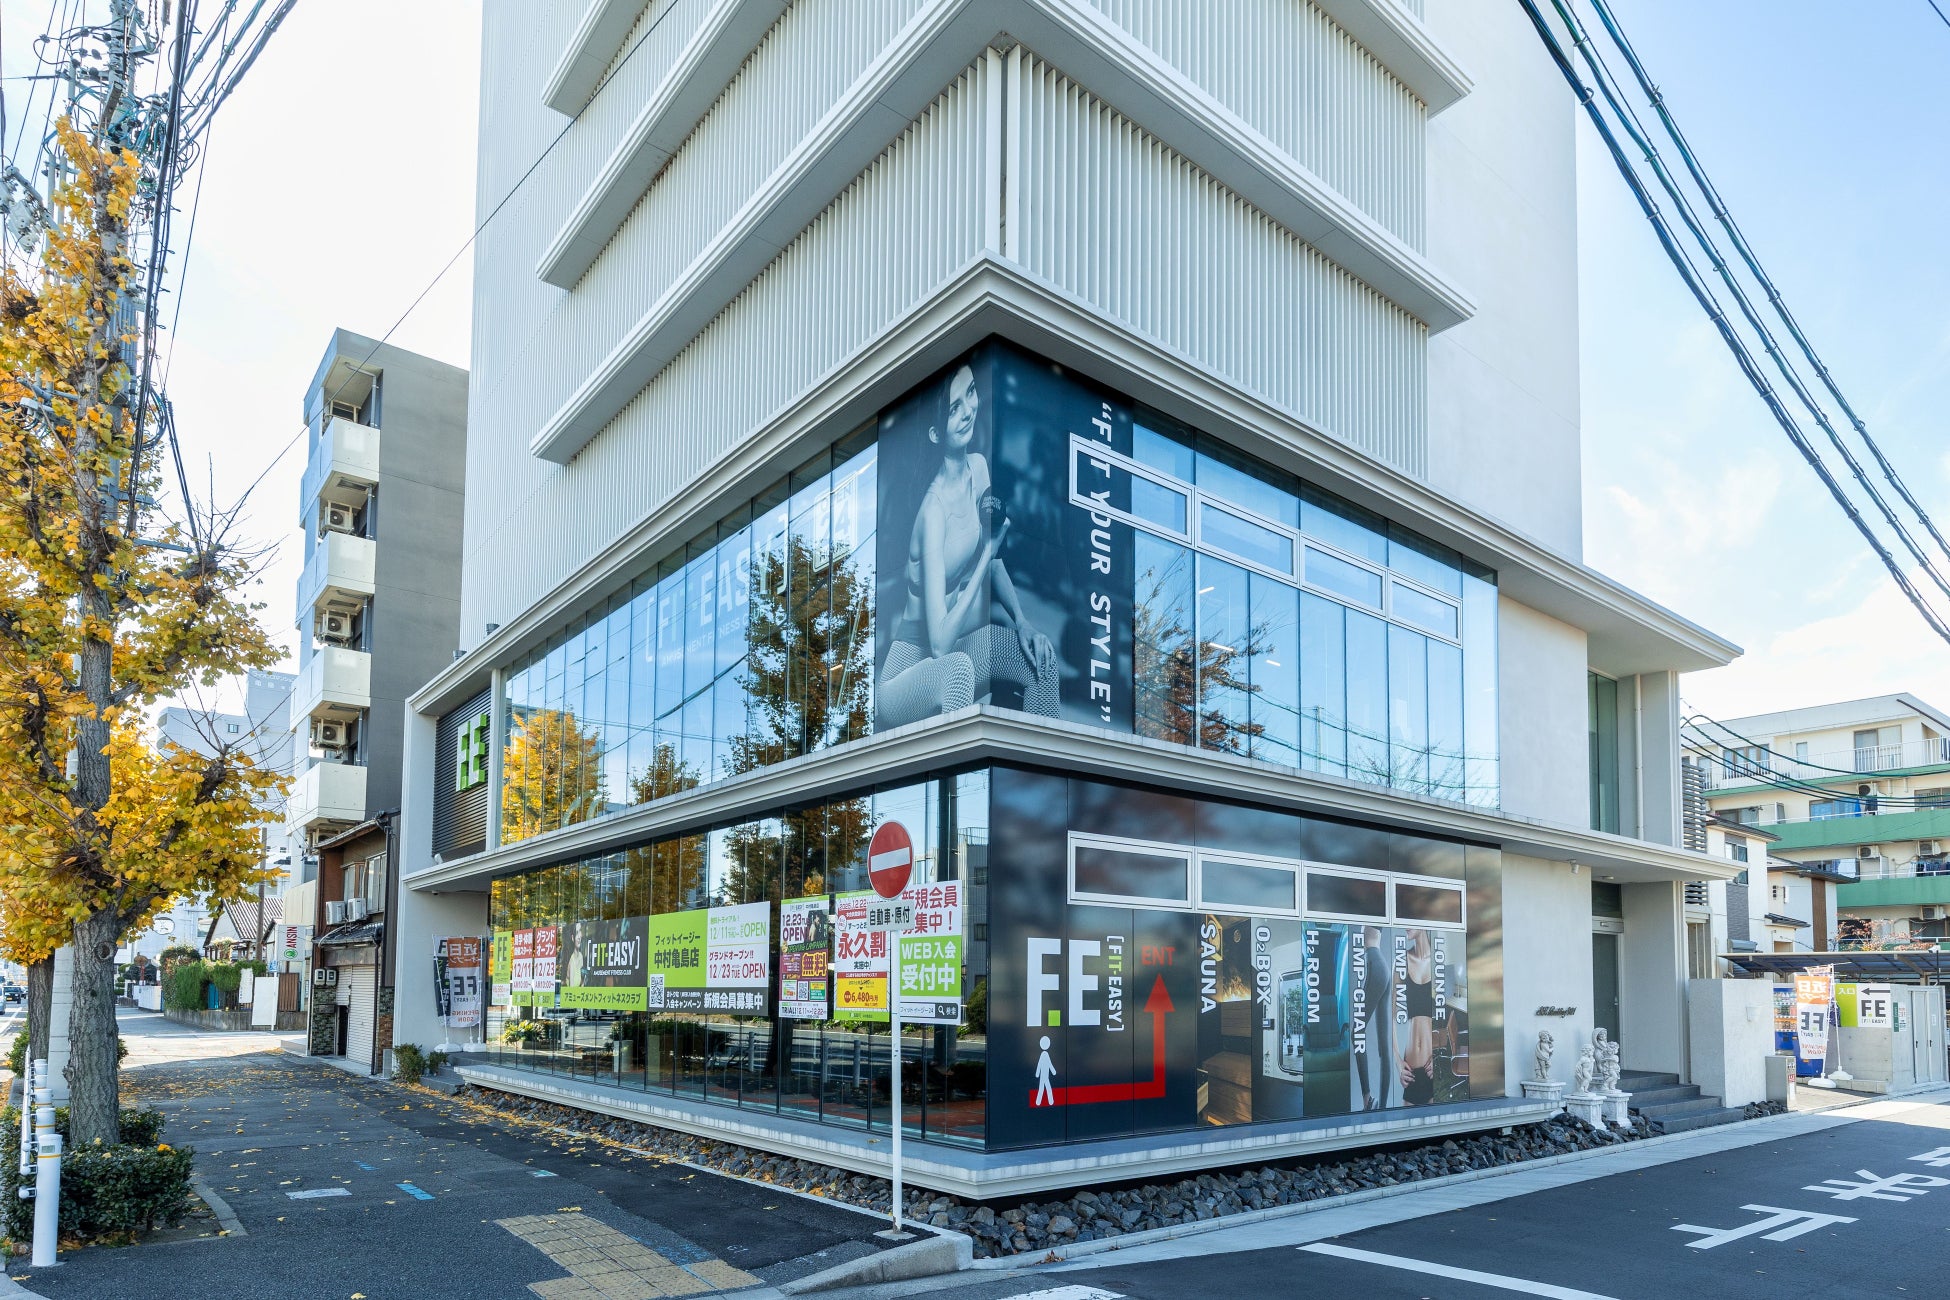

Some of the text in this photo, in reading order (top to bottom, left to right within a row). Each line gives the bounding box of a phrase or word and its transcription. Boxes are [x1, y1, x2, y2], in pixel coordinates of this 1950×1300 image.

[869, 906, 911, 926] 自動車・原付
[902, 911, 952, 935] 集中！
[286, 926, 298, 949] ANSIN
[536, 930, 555, 944] グランド
[655, 931, 701, 945] フィットイージー
[744, 921, 767, 938] OPEN
[536, 943, 555, 957] オープン
[838, 930, 887, 959] 永久割
[901, 941, 957, 960] WEB入会
[654, 946, 700, 969] 中村亀島店
[802, 952, 827, 976] 無料
[1141, 945, 1176, 967] ENT
[535, 962, 555, 977] 12/23
[709, 964, 731, 979] 12/23
[742, 963, 766, 979] OPEN
[901, 962, 956, 992] 受付中
[1200, 923, 1217, 1015] SAUNA
[1434, 936, 1446, 1021] LOUNGE
[1395, 935, 1408, 1025] EMP M/C
[564, 992, 642, 1004] アミューズメントフィットネスクラブ
[704, 992, 763, 1010] 新規会員募集中
[1352, 932, 1366, 1055] EMP-CHAIR
[1838, 987, 1856, 995] 入口
[665, 998, 702, 1009] 入会キャンペーン
